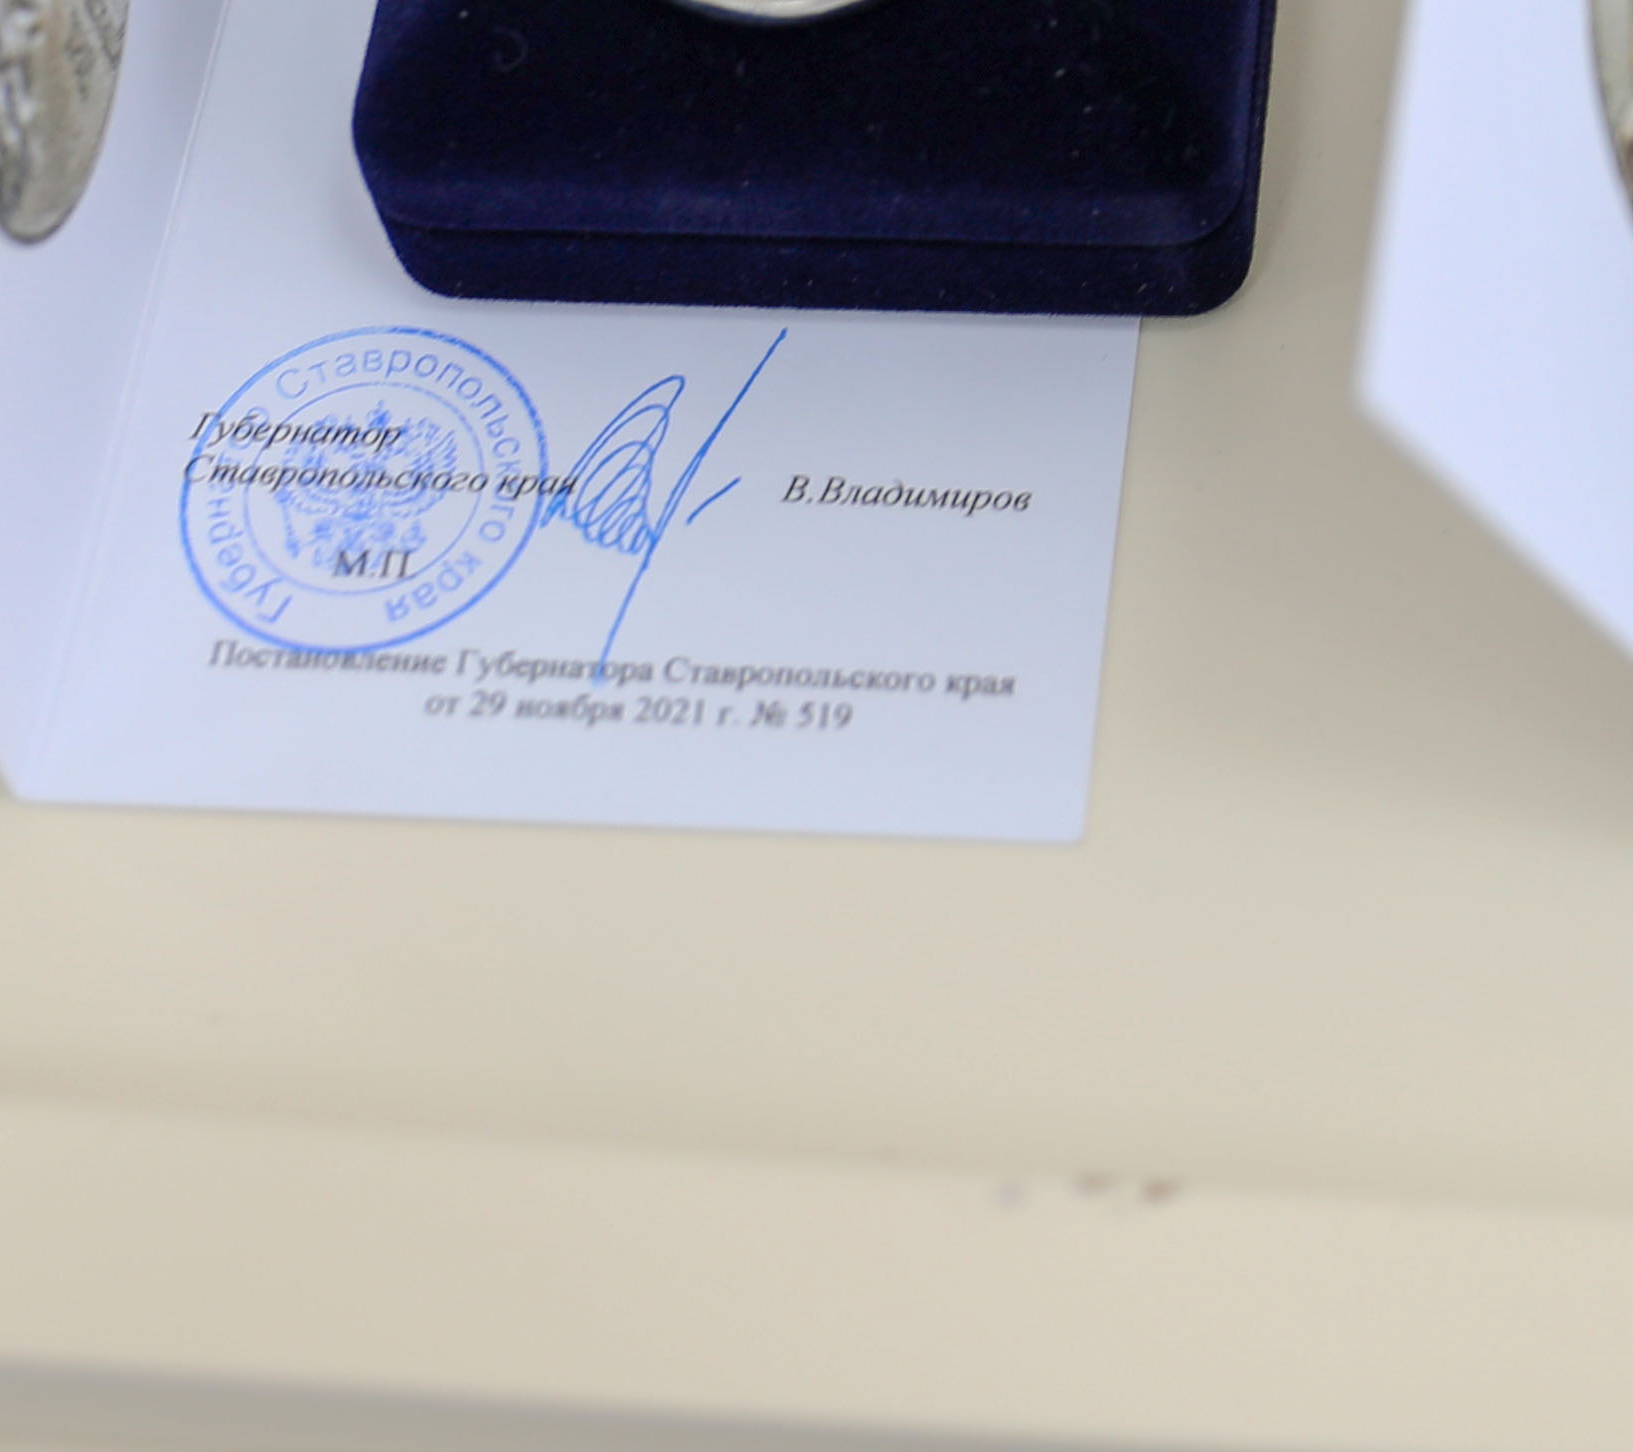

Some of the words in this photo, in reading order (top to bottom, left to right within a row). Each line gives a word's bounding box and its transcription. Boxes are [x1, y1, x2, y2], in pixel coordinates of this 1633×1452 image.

[189, 411, 403, 452] Губернатор
[185, 454, 489, 494] Ставропольского
[496, 472, 579, 500] края
[781, 473, 1033, 517] В.Владимиров
[209, 639, 446, 675] Постановление
[457, 648, 653, 684] Губернатора
[664, 655, 937, 692] Ставропольского
[946, 672, 1016, 700] края
[425, 695, 459, 716] от
[470, 689, 508, 717] 29
[515, 697, 624, 727] ноября
[635, 697, 705, 725] 2021
[797, 701, 854, 730] 519
